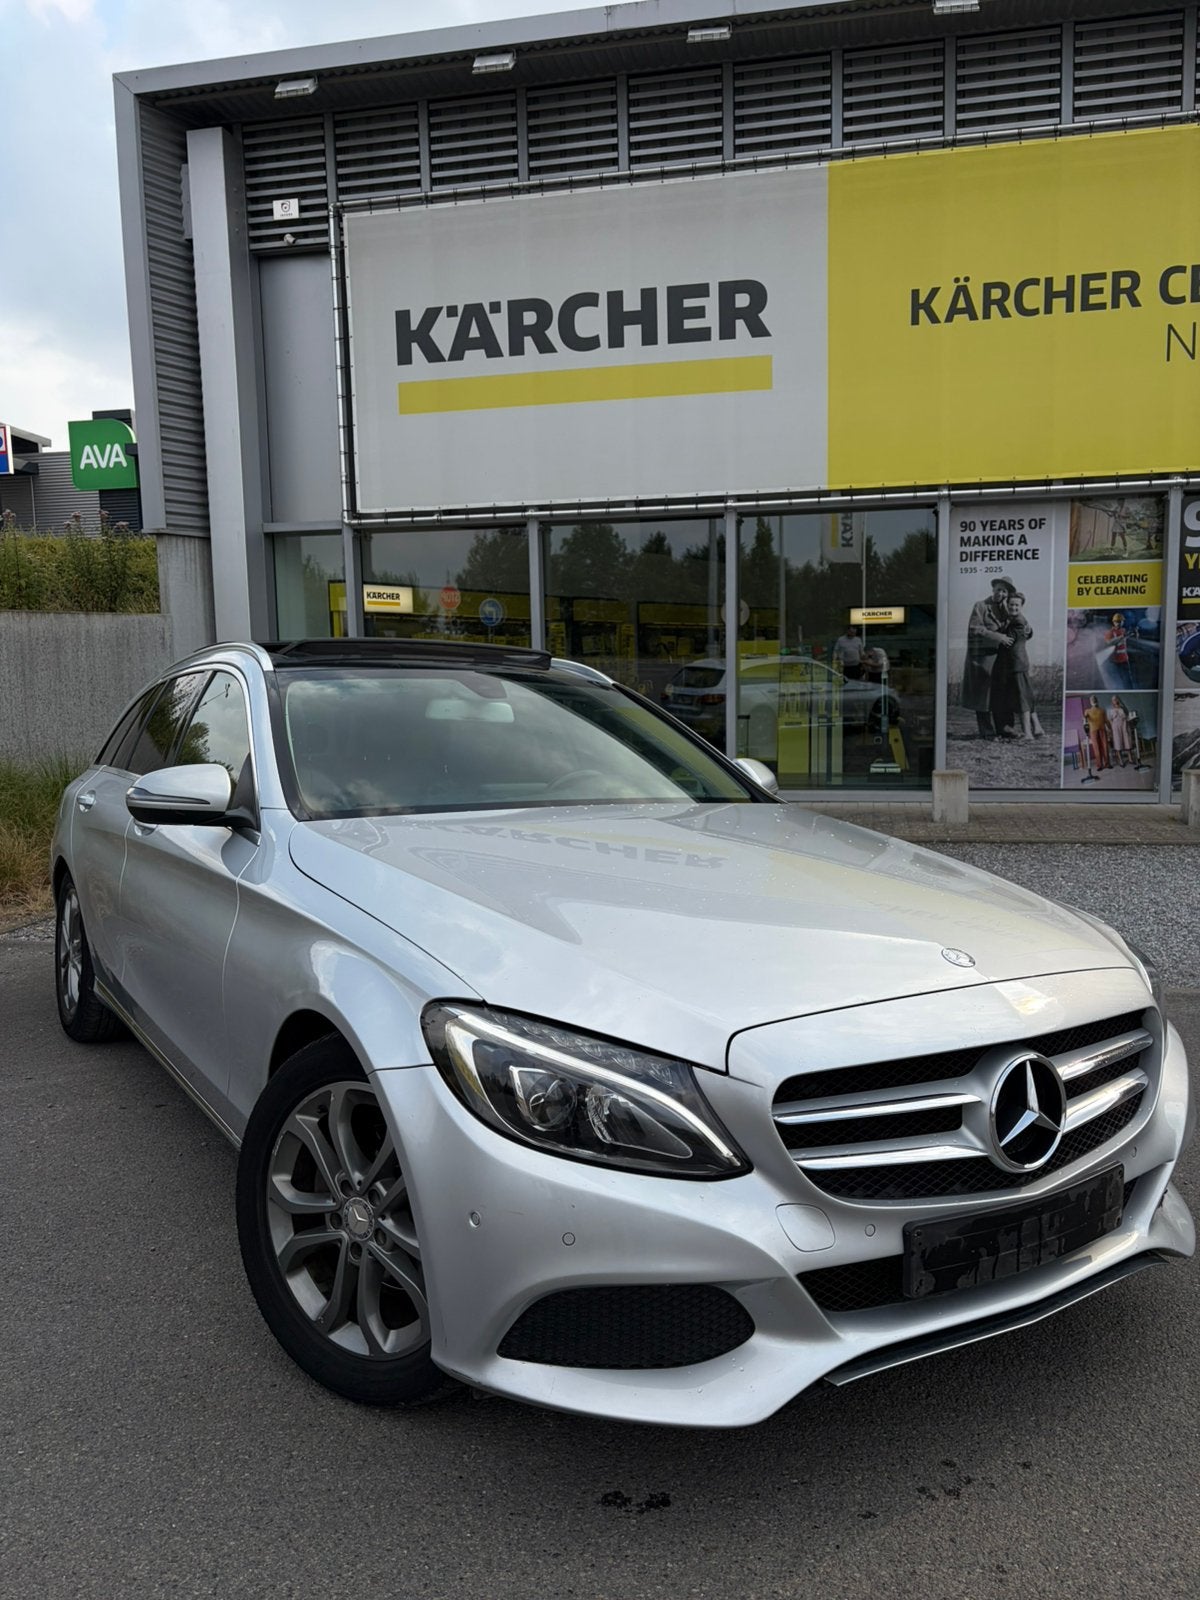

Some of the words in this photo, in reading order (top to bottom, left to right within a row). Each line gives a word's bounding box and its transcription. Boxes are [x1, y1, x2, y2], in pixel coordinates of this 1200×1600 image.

[910, 270, 1142, 326] KÄRCHER
[395, 279, 772, 366] KÄRCHER
[79, 443, 128, 470] AVA
[960, 520, 976, 533] 90
[979, 518, 1025, 532] YEARS
[1028, 517, 1046, 530] OF
[960, 534, 1014, 548] MAKING
[1017, 533, 1028, 546] A
[960, 549, 1040, 563] DIFFERENCE
[1185, 553, 1200, 570] Y
[960, 566, 978, 574] 1935
[1077, 574, 1148, 585] CELEBRATING
[1077, 586, 1090, 596] BY
[1094, 585, 1146, 596] CLEANING
